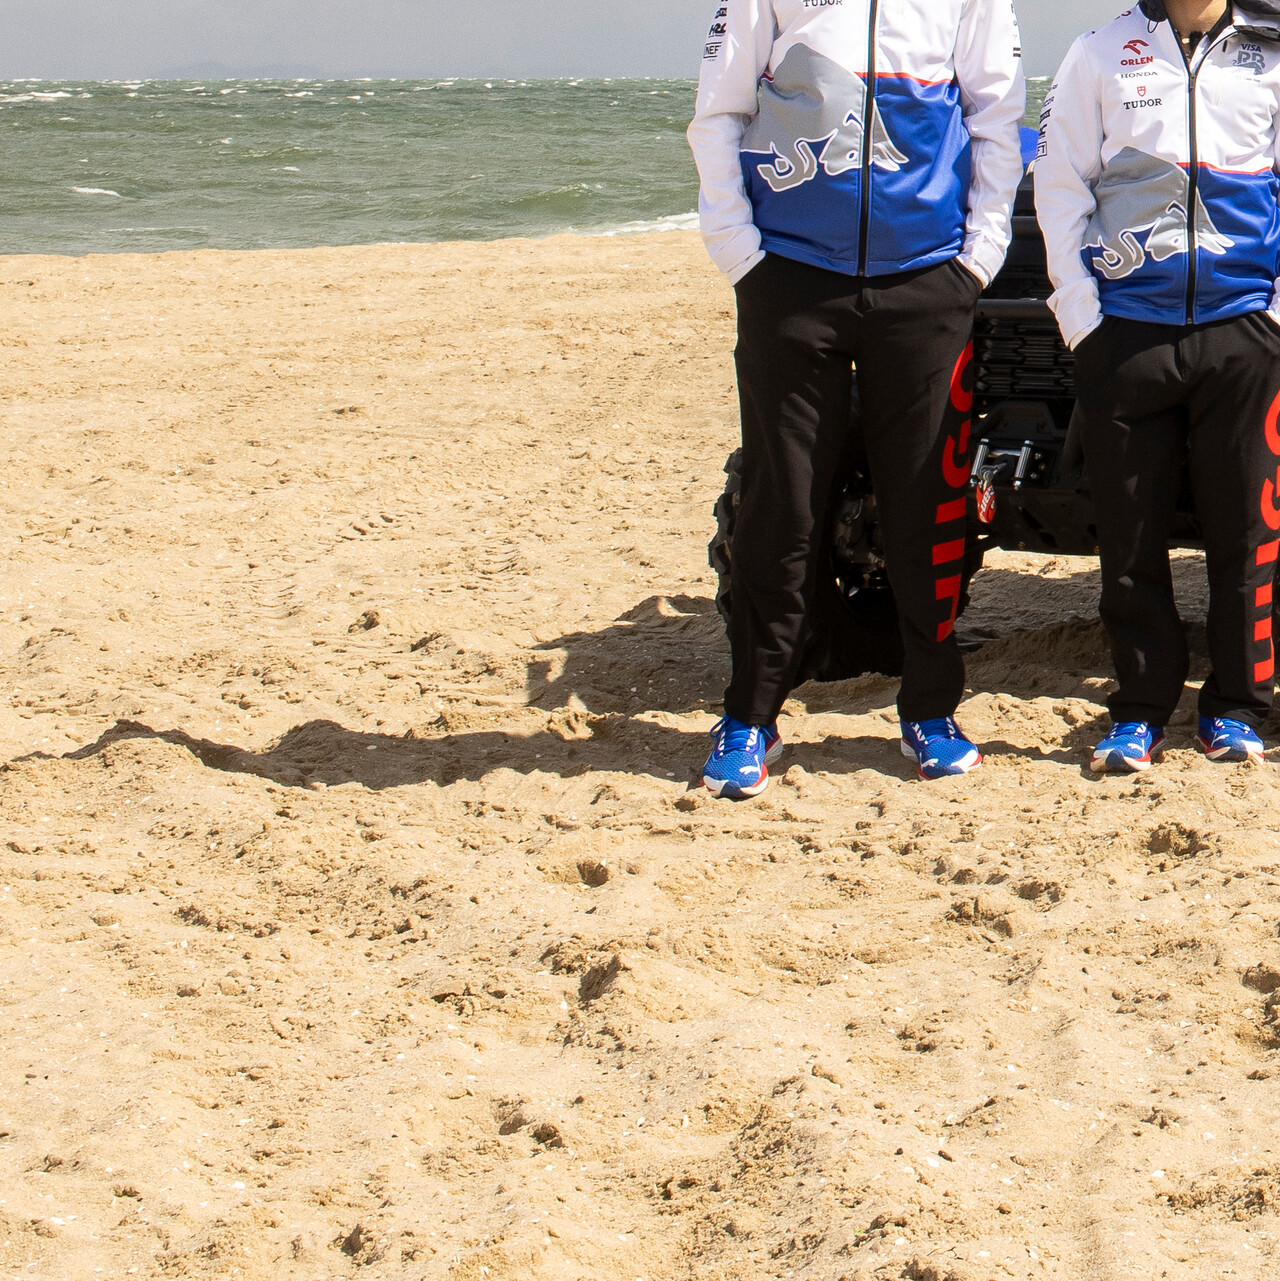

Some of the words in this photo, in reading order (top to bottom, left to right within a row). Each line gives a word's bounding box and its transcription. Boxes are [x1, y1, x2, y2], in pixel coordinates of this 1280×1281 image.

[1240, 43, 1262, 52] VISA
[1120, 56, 1154, 66] ORLEN
[1121, 71, 1158, 79] HONDA
[1123, 98, 1162, 110] TUDOR
